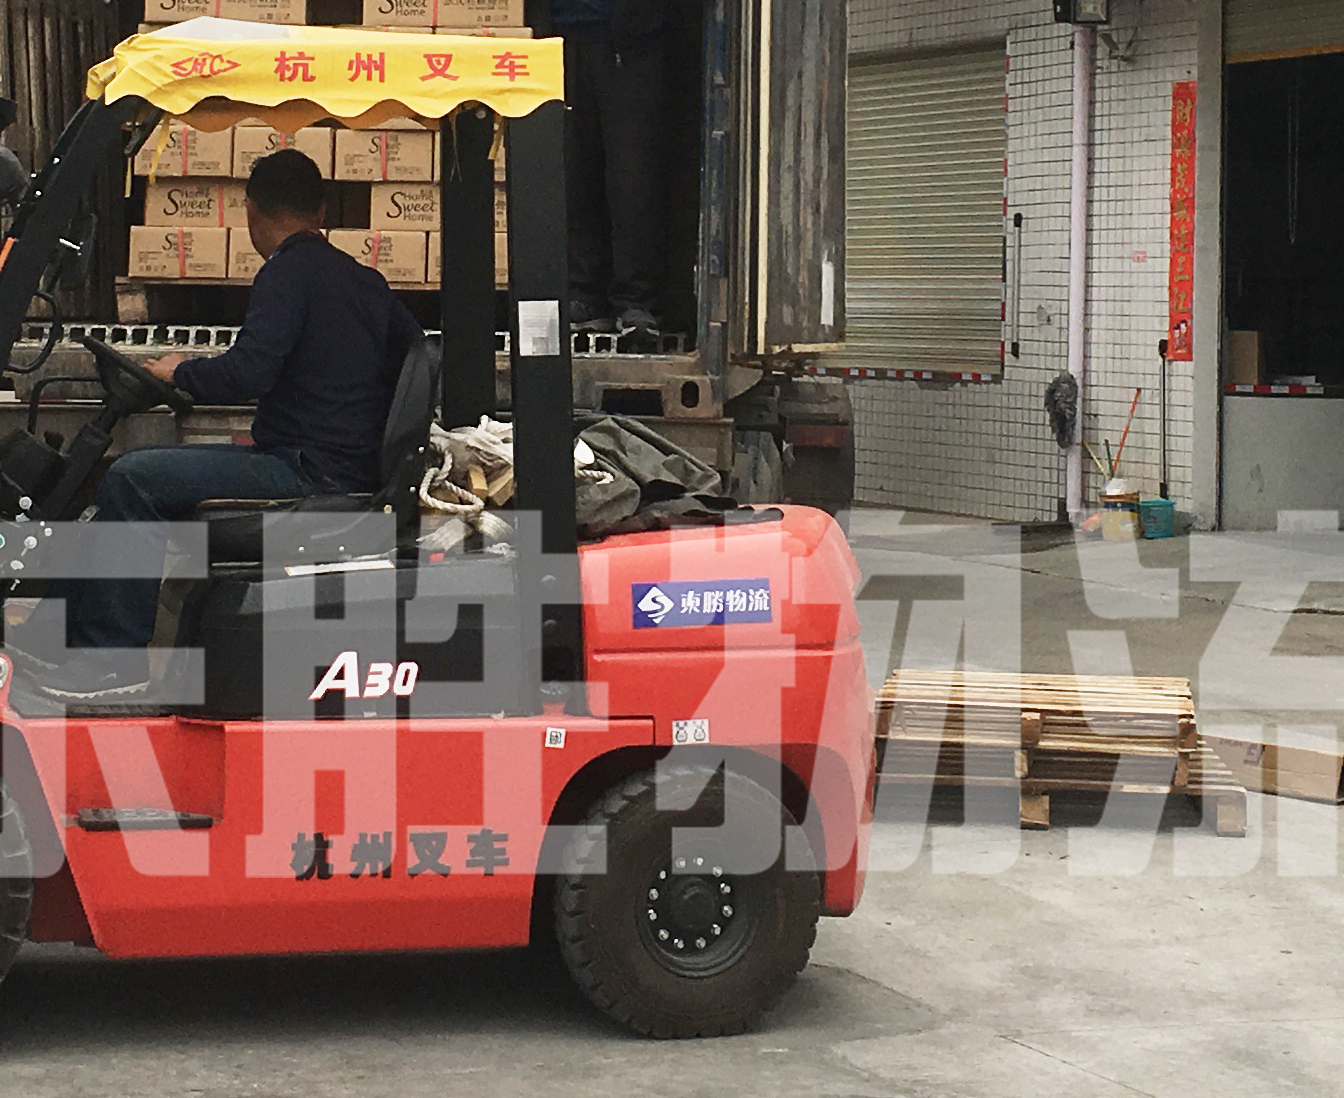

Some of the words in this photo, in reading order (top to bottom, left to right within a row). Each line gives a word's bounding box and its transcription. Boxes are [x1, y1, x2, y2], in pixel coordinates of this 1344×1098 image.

[274, 50, 531, 83] 杭州叉车
[308, 650, 419, 701] A30
[290, 828, 510, 881] 杭州叉车
